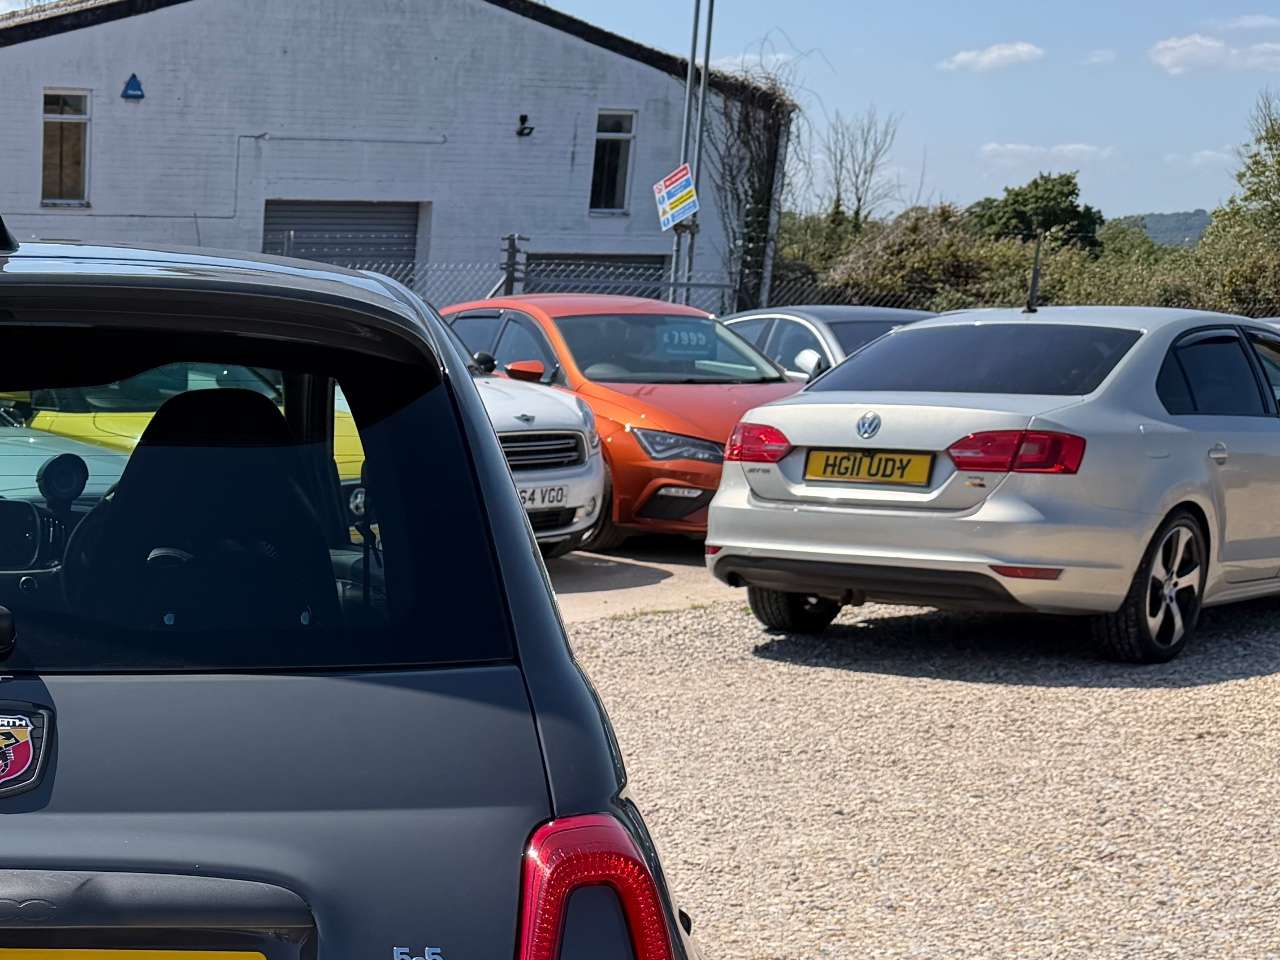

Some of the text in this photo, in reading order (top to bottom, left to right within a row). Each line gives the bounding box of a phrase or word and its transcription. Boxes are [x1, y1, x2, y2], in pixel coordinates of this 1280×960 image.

[822, 455, 912, 478] HG11 UDY
[540, 487, 563, 504] VGO
